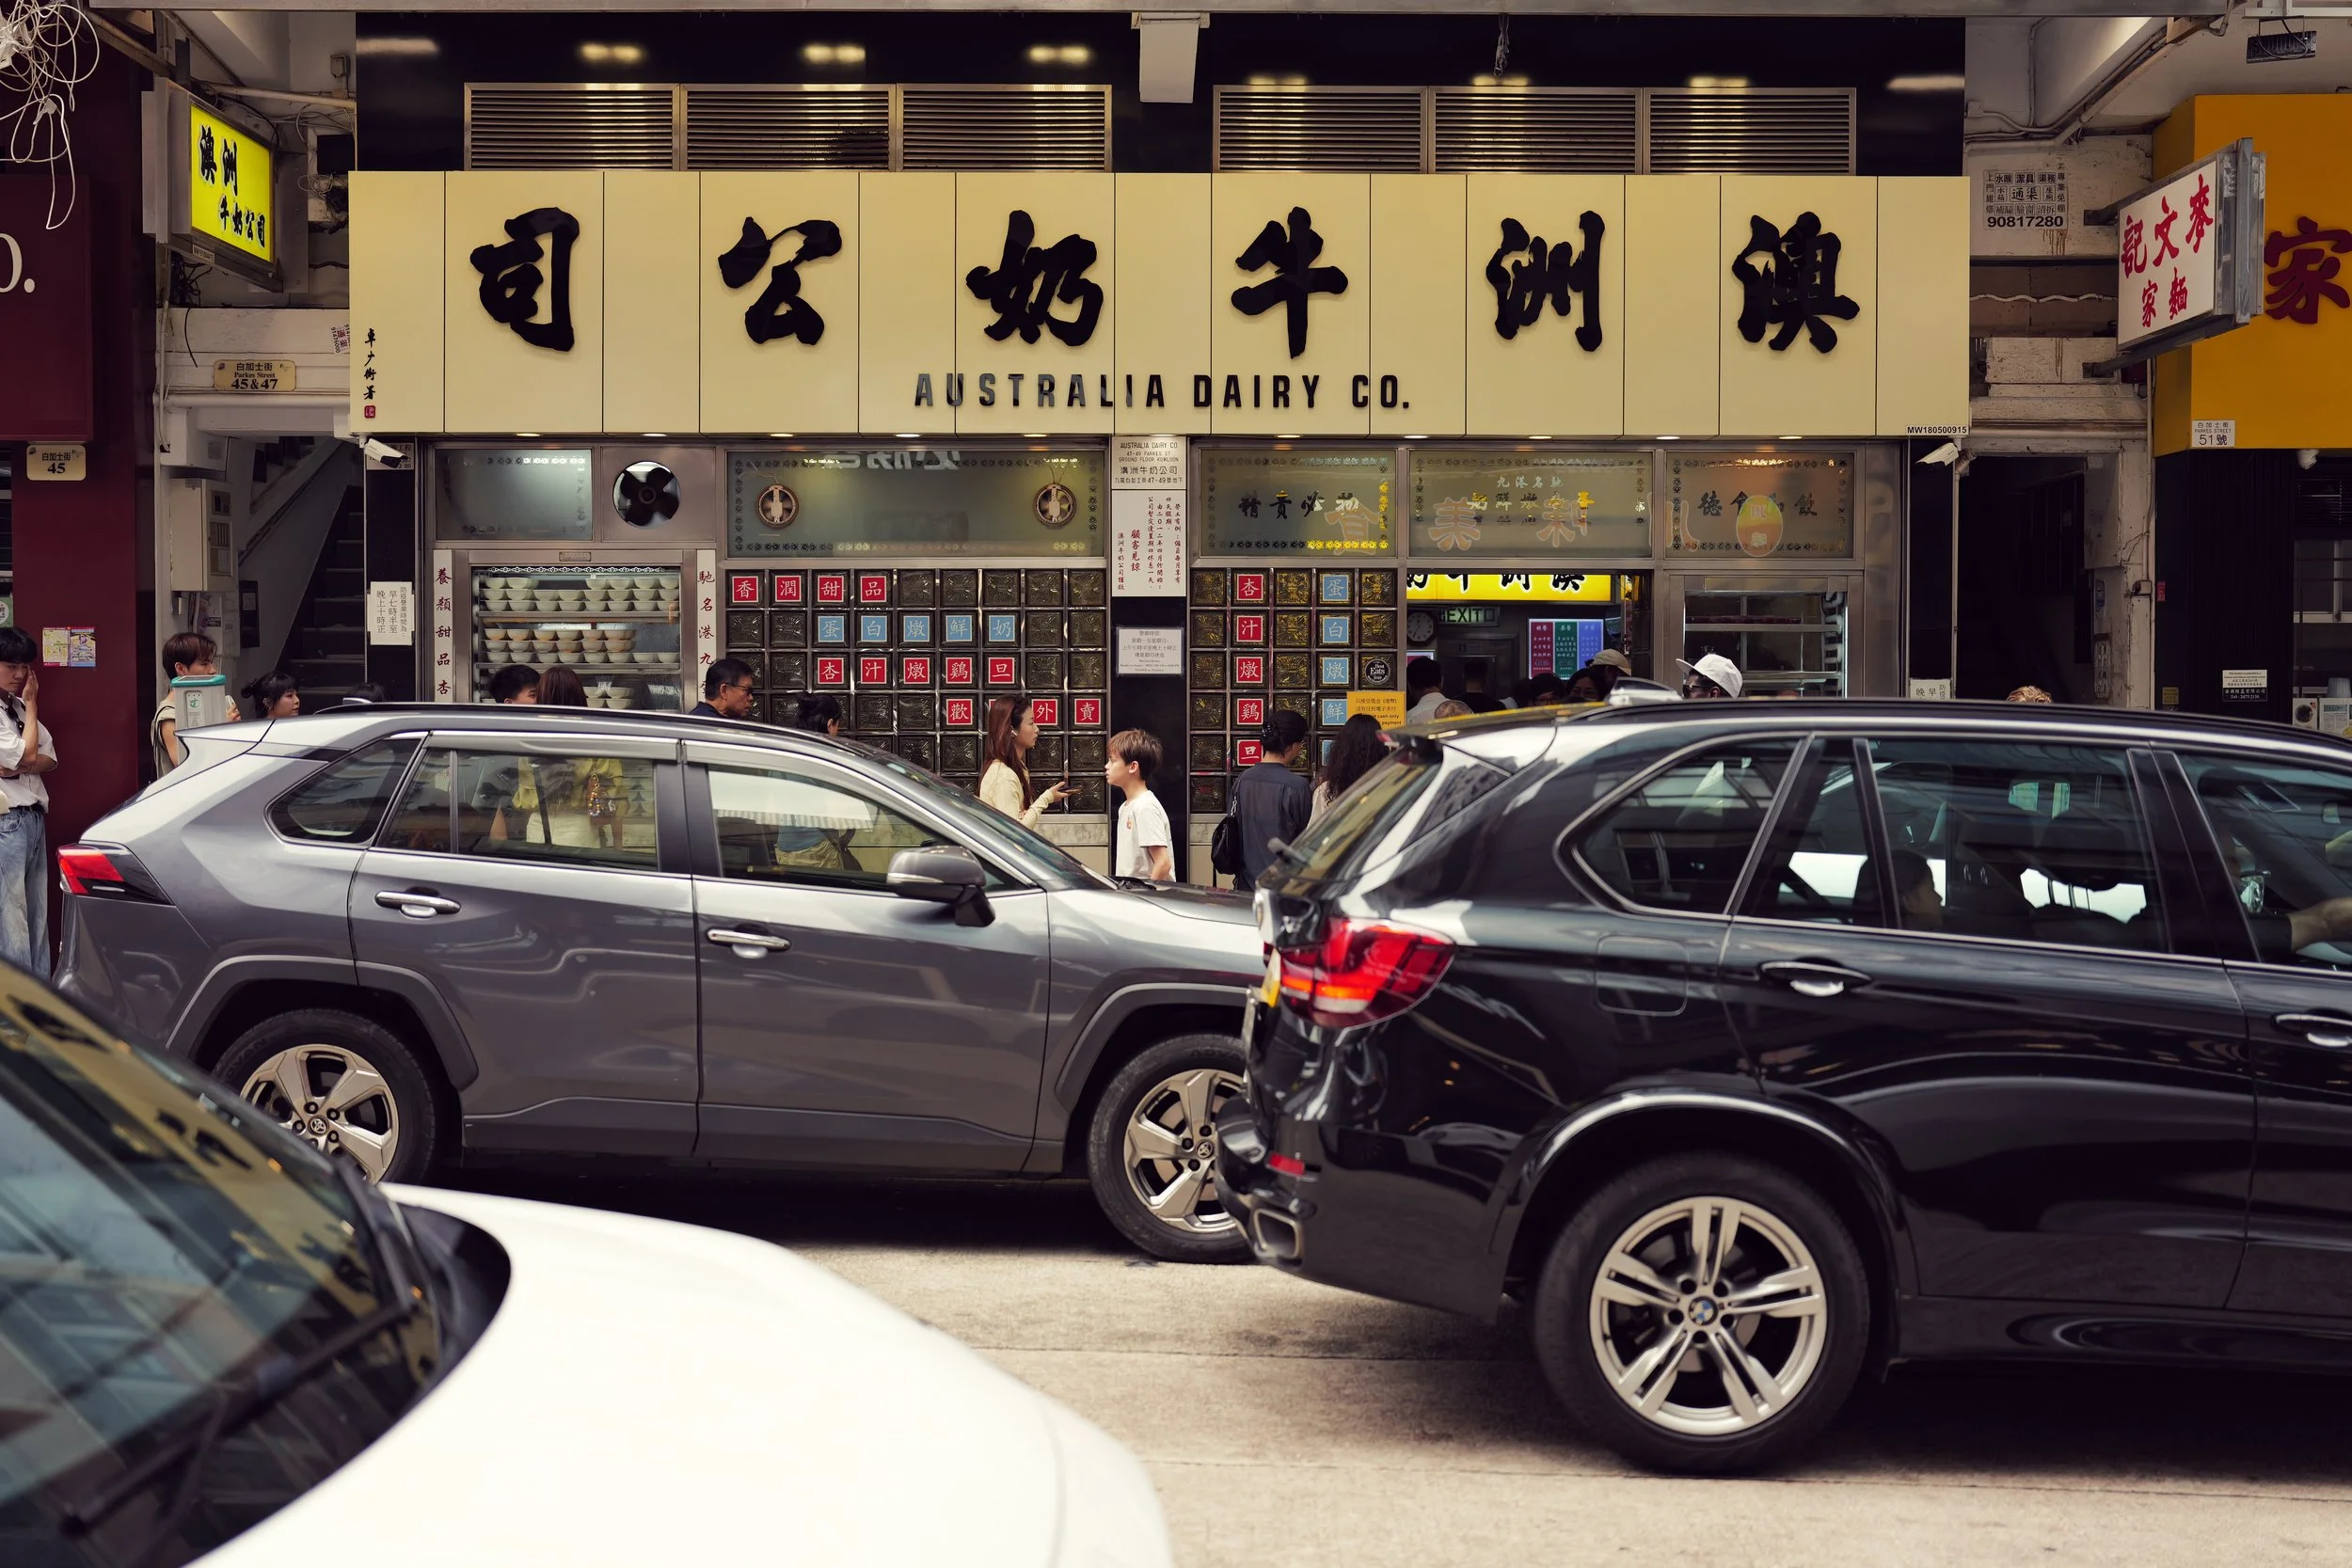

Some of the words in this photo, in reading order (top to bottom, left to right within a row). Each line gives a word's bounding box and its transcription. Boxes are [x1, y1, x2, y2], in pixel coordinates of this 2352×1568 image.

[200, 125, 237, 196] 澳洲
[2011, 187, 2039, 201] 通渠
[220, 195, 265, 248] 牛奶公司
[1987, 215, 2064, 228] 90817280
[2121, 174, 2214, 279] 麥文記
[2264, 215, 2352, 325] 家
[236, 362, 273, 372] 白加士街
[231, 378, 278, 389] 45&47
[914, 372, 1166, 408] AUSTRALIA
[1193, 373, 1321, 409] DAIRY
[1352, 375, 1411, 410] CO.
[1906, 425, 1967, 435] MW180500915
[41, 452, 72, 461] 白加士街
[46, 463, 66, 474] 45
[1120, 467, 1178, 475] 澳洲牛奶公司
[1697, 490, 1818, 517] 飲德
[1131, 529, 1140, 572] 顧客見諒
[734, 578, 887, 600] 香潤甜品
[377, 591, 386, 634] 晚上十時正
[389, 591, 397, 634] 早七時半至
[1447, 608, 1484, 623] EXIT
[820, 618, 1013, 640] 蛋白燉鮮奶
[1326, 578, 1345, 720] 蛋白燉鮮
[949, 703, 1096, 721] 歡外賣
